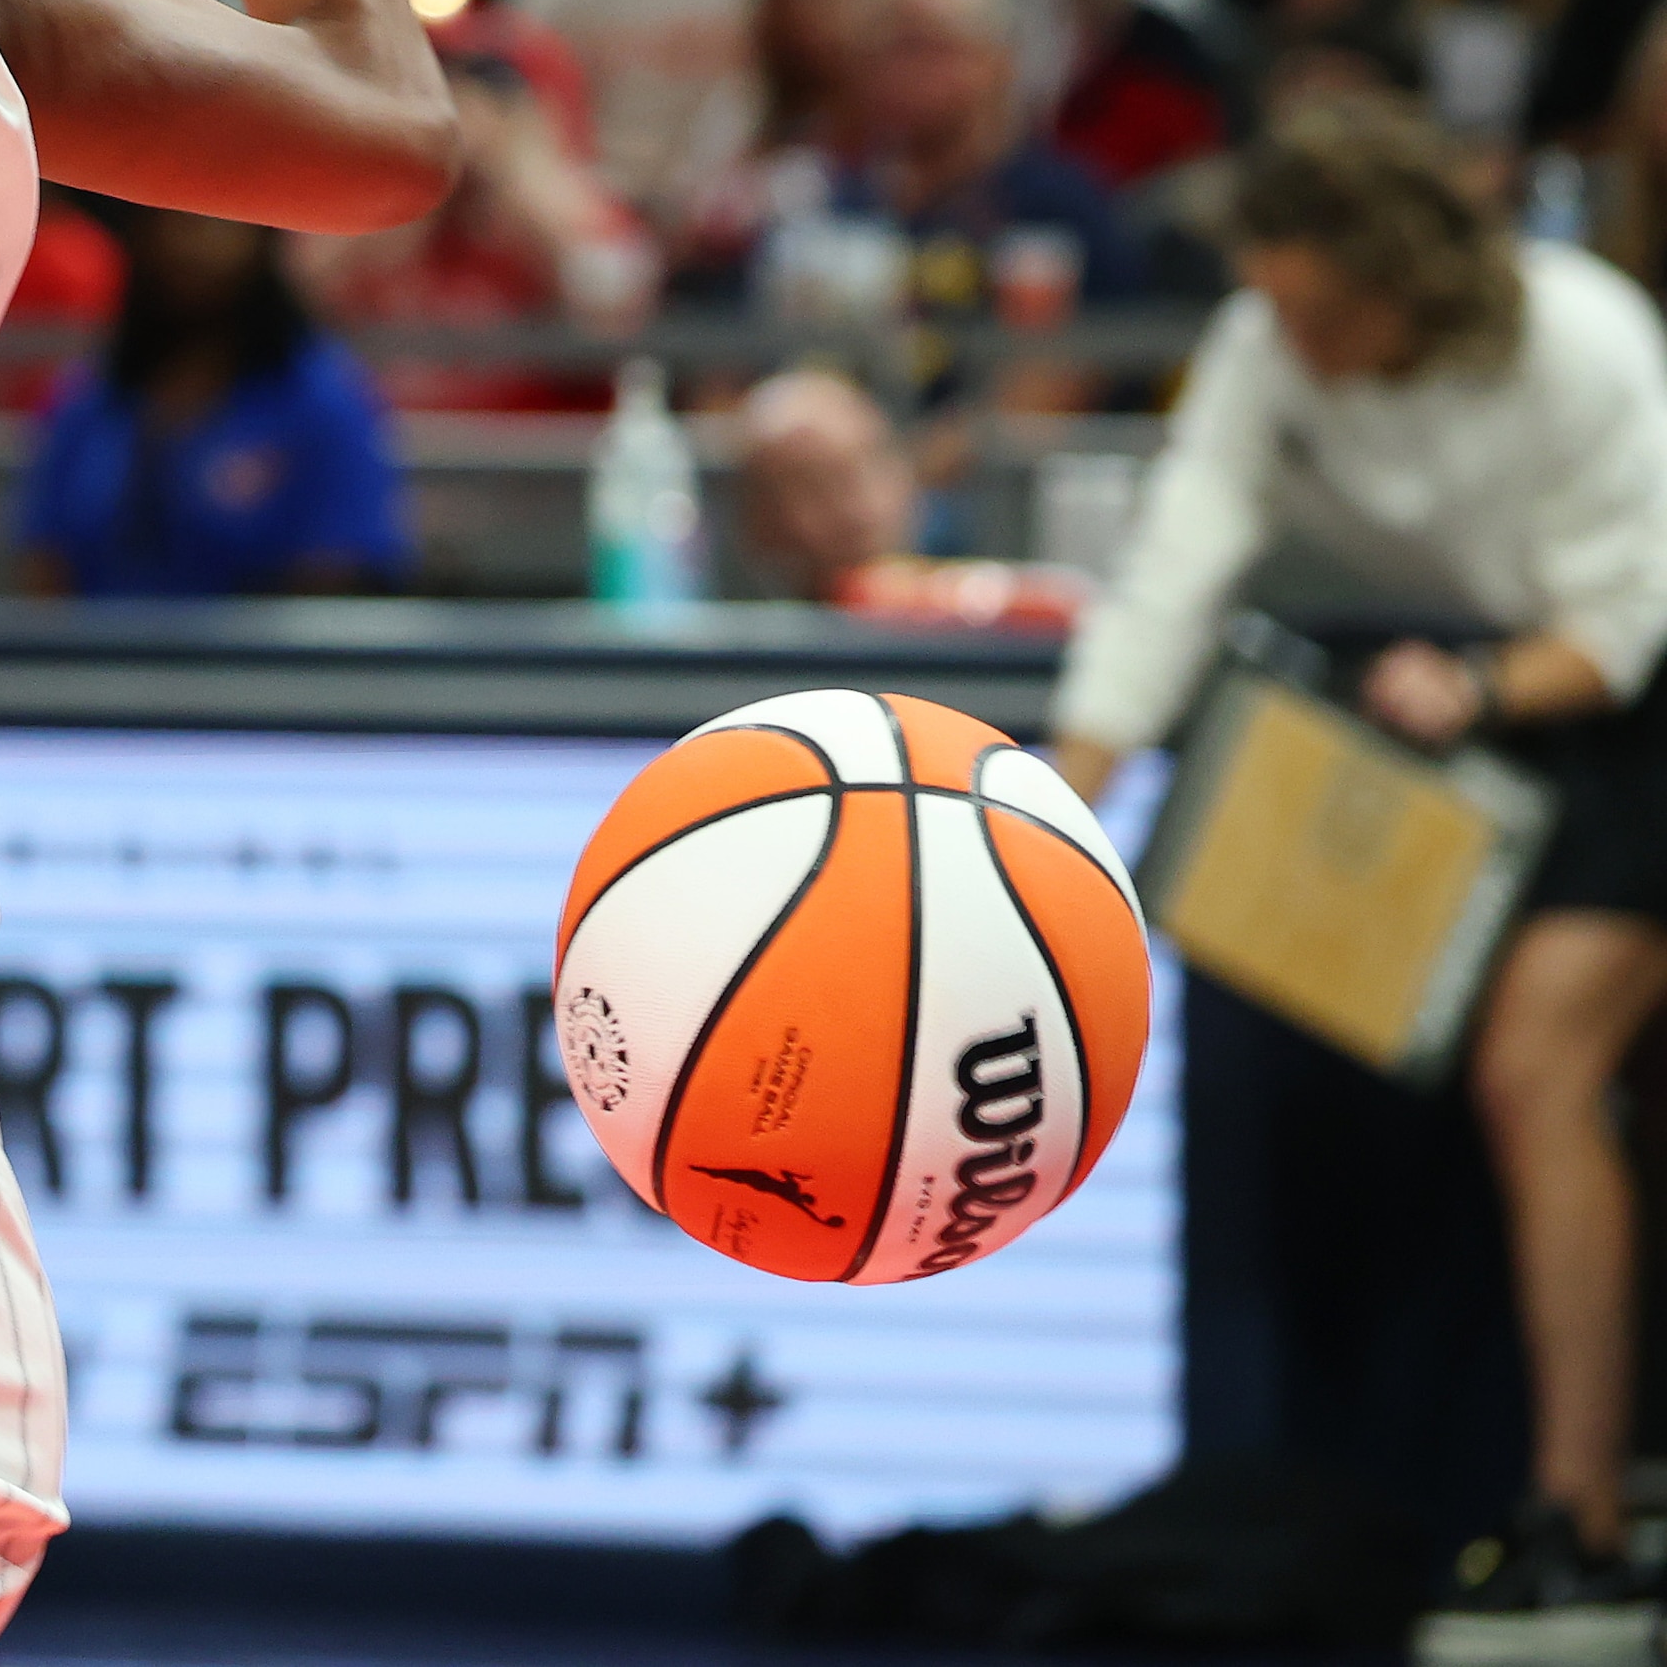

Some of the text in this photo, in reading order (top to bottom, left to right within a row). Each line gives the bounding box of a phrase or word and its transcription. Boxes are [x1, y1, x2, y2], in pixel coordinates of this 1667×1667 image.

[768, 1026, 800, 1088] GAME
[773, 1046, 813, 1131] OFFICIAL
[751, 1088, 780, 1136] BALL
[903, 1011, 1045, 1281] Wilso
